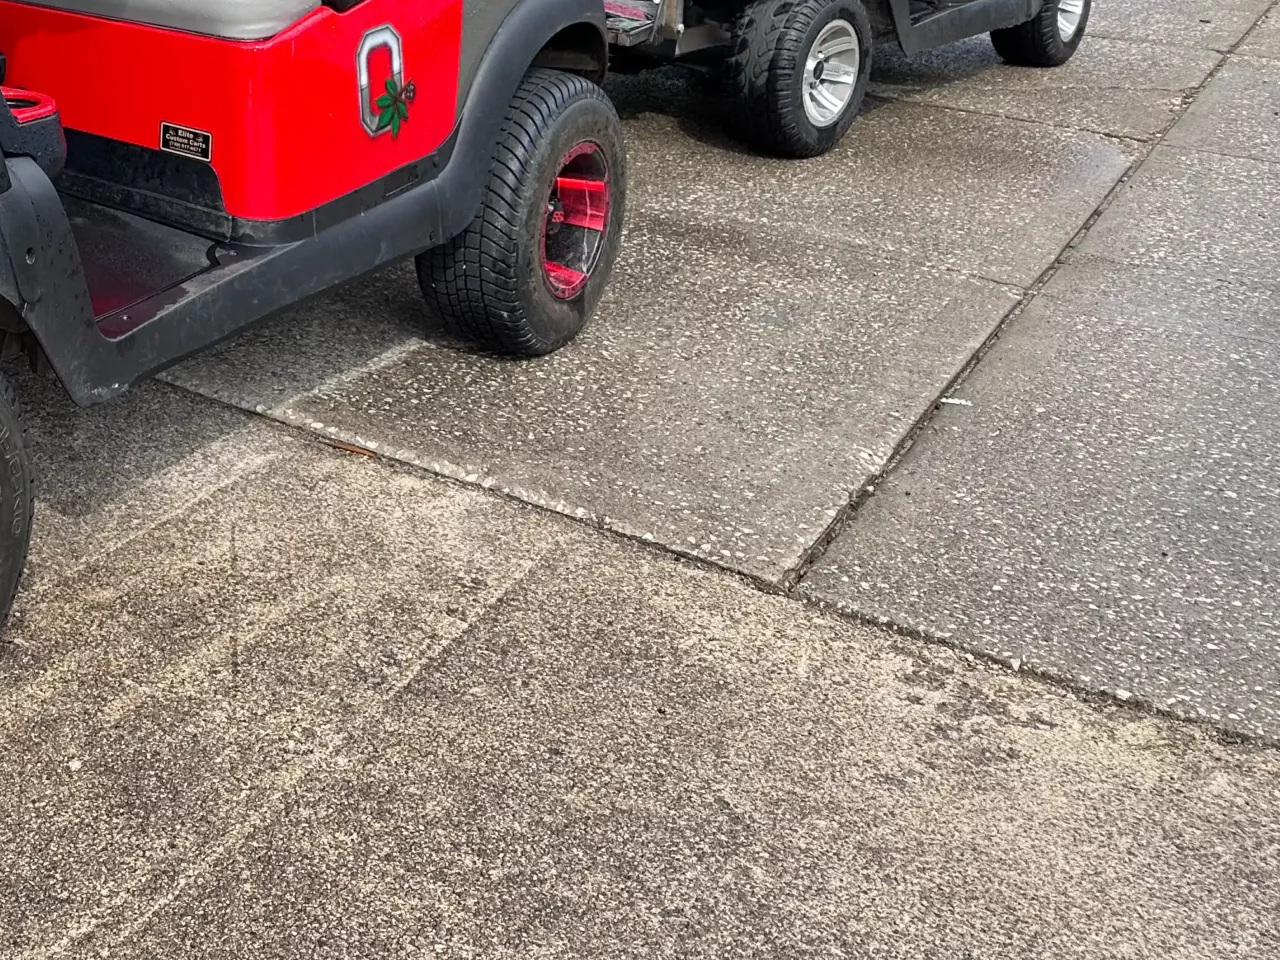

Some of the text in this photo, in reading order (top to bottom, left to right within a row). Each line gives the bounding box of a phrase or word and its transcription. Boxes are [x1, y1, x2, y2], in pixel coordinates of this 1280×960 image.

[178, 129, 194, 139] Elite
[165, 133, 206, 149] Custom Carts
